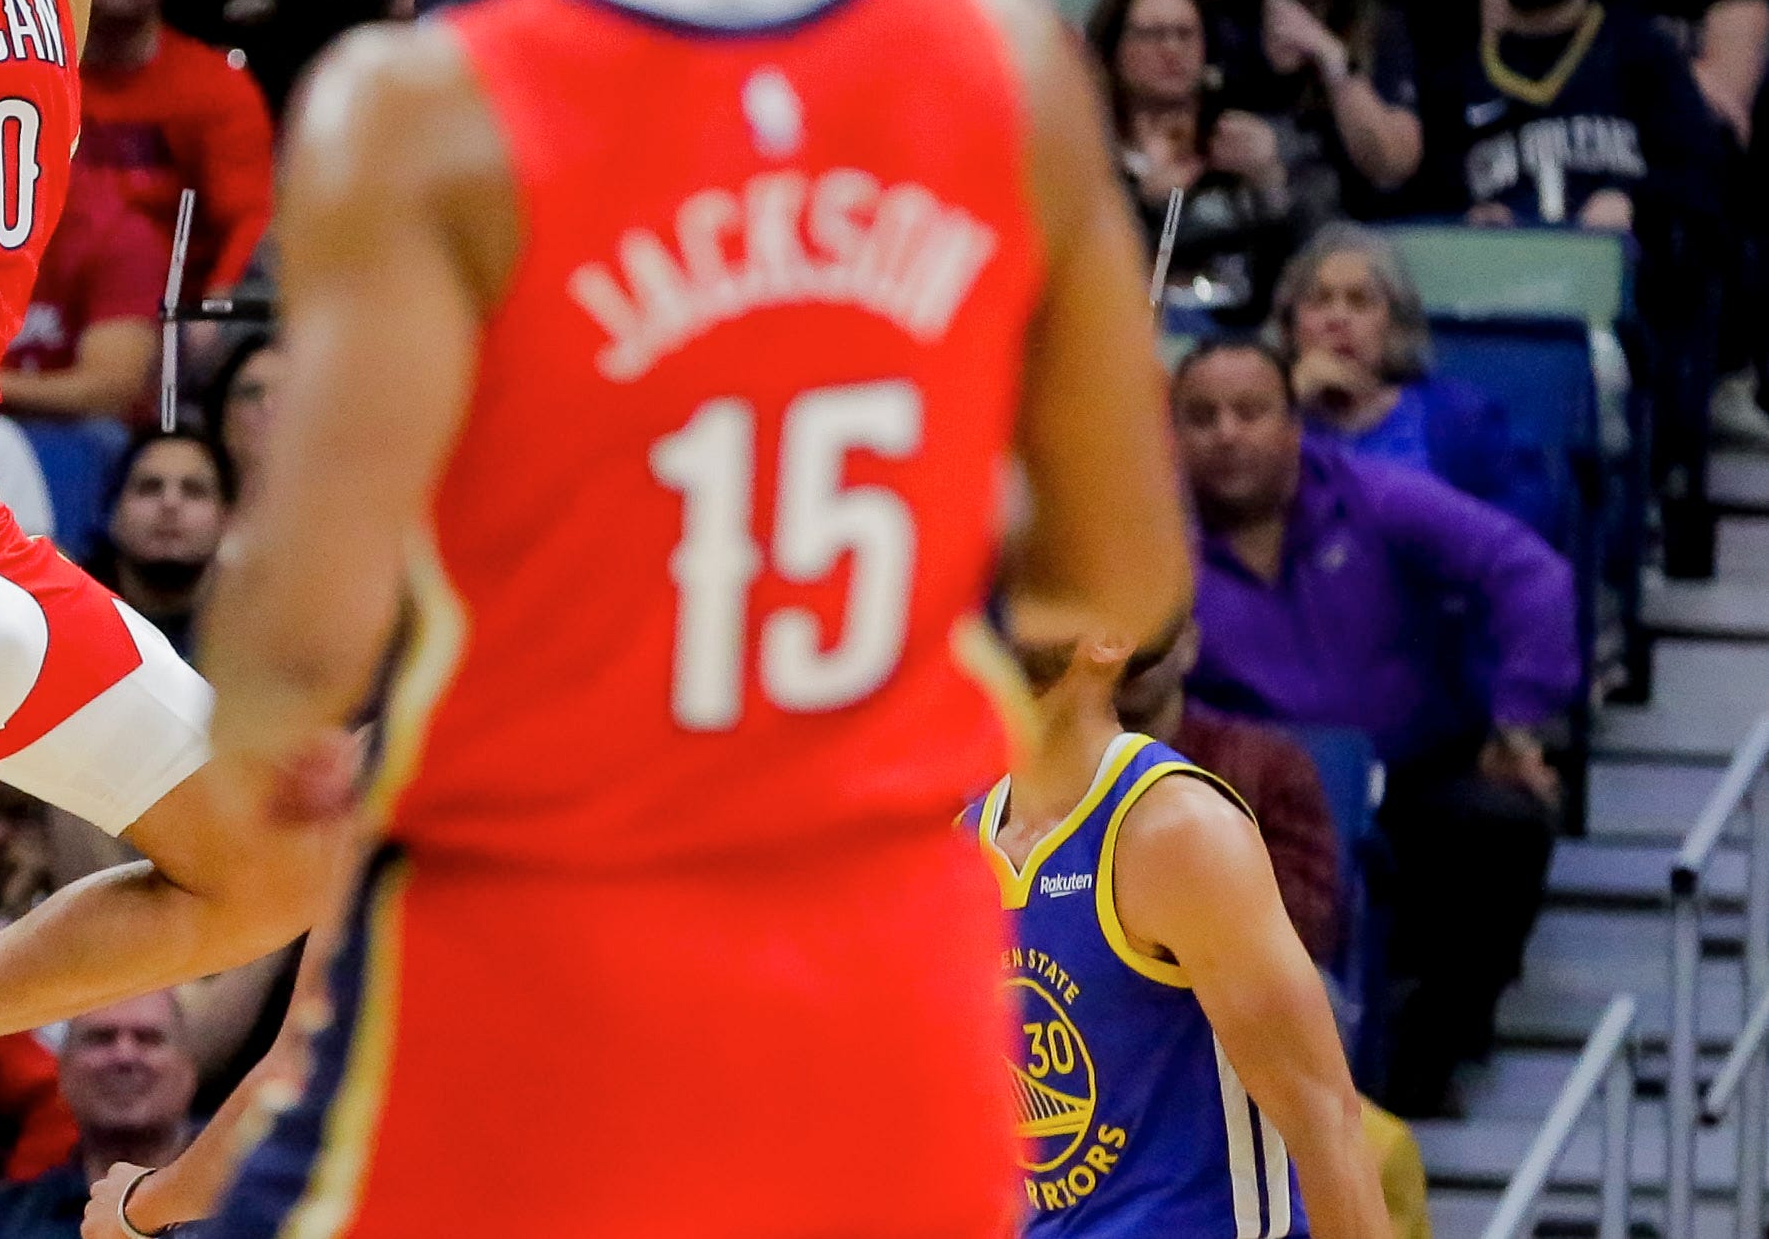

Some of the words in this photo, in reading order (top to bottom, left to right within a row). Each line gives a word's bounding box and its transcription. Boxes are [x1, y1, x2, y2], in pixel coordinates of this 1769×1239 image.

[567, 165, 998, 383] JACKSON
[647, 376, 924, 734] 15
[1040, 873, 1093, 895] Rakuten
[1027, 947, 1080, 1006] STATE
[1022, 1019, 1075, 1080] 30
